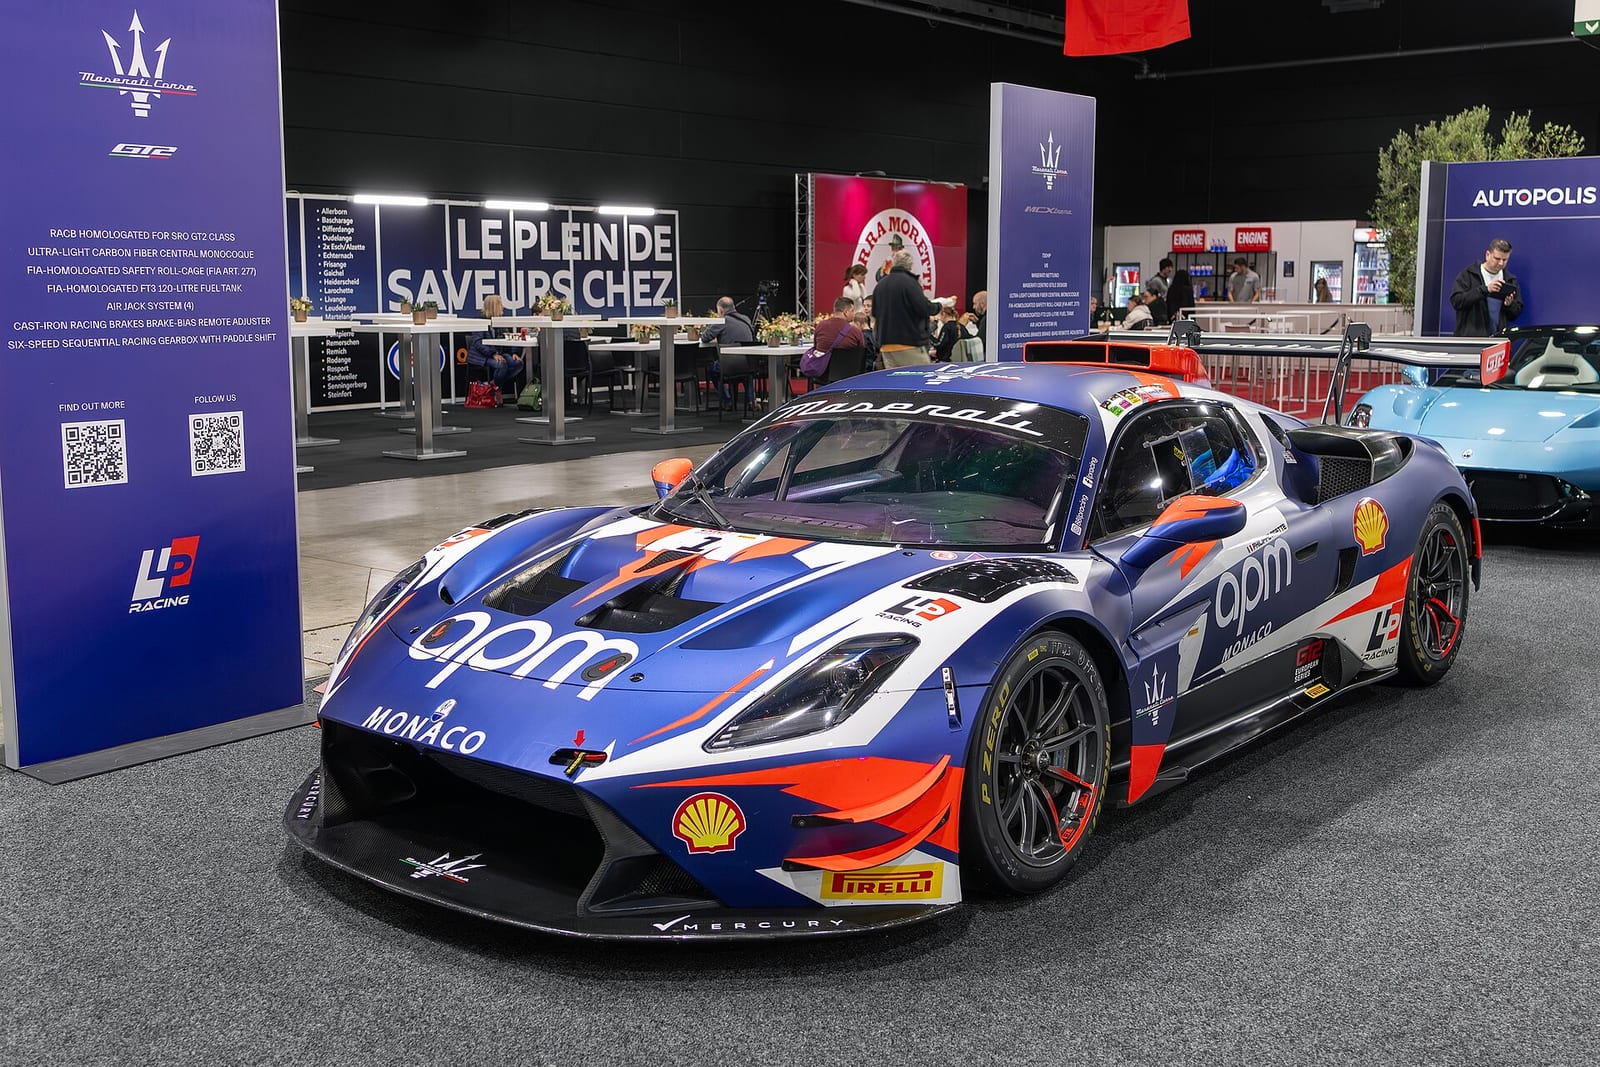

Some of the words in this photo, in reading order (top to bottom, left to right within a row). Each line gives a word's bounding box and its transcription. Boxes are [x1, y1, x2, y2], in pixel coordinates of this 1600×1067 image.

[79, 71, 153, 87] Maserati
[153, 79, 197, 92] Corse
[111, 143, 178, 156] GT2
[1472, 186, 1598, 208] AUTOPOLIS
[50, 228, 77, 238] RACB
[79, 229, 150, 240] HOMOLOGATED
[152, 231, 170, 240] FOR
[171, 232, 189, 240] SRO
[191, 232, 207, 241] GT2
[208, 233, 236, 241] CLASS
[322, 226, 355, 235] Differdange
[1237, 231, 1269, 244] ENGINE
[457, 218, 504, 260] LE
[515, 219, 619, 262] PLEIN
[629, 224, 673, 263] DE
[1173, 233, 1204, 246] ENGINE
[28, 247, 90, 257] ULTRA-LIGHT
[92, 248, 131, 257] CARBON
[133, 248, 158, 258] FIBER
[160, 249, 199, 258] CENTRAL
[200, 249, 255, 259] MONOCOQUE
[888, 216, 932, 292] MORETTI
[27, 265, 120, 275] FIA-HOMOLOGATED
[122, 266, 156, 275] SAFETY
[157, 266, 205, 275] ROLL-CAGE
[206, 266, 223, 277] (FIA
[223, 267, 240, 276] ART.
[241, 267, 257, 277] 277)
[47, 284, 139, 293] FIA-HOMOLOGATED
[140, 283, 157, 293] FT3
[158, 283, 199, 293] 120-LITRE
[200, 283, 220, 293] FUEL
[221, 283, 243, 293] TANK
[387, 269, 575, 313] SAVEURS
[582, 270, 673, 309] CHEZ
[106, 302, 122, 311] AIR
[123, 301, 146, 311] JACK
[147, 301, 182, 311] SYSTEM
[184, 301, 195, 312] (4)
[13, 320, 68, 331] CAST-IRON
[70, 320, 107, 330] RACING
[109, 319, 145, 329] BRAKES
[146, 318, 197, 328] BRAKE-BIAS
[198, 317, 231, 327] REMOTE
[232, 316, 271, 326] ADJUSTER
[7, 339, 60, 350] SIX-SPEED
[62, 337, 121, 348] SEQUENTIAL
[121, 336, 157, 347] RACING
[158, 335, 199, 345] GEARBOX
[200, 334, 221, 344] WITH
[222, 333, 253, 343] PADDLE
[254, 333, 277, 342] SHIFT
[59, 403, 80, 412] FIND
[81, 402, 99, 411] OUT
[100, 400, 126, 410] MORE
[194, 394, 225, 404] FOLLOW
[226, 393, 237, 402] US
[771, 399, 1044, 437] Maserati
[1215, 537, 1292, 637] apm
[128, 595, 190, 614] RACING
[874, 612, 923, 628] RACING
[1221, 621, 1272, 664] MONACO
[408, 611, 640, 702] apm
[1295, 659, 1320, 676] EUROPEAN
[1294, 670, 1311, 683] SERIES
[361, 705, 488, 755] MONACO
[982, 681, 1010, 776] ZERO
[981, 783, 991, 805] P
[831, 869, 935, 894] PIRELLI
[682, 918, 845, 932] MERCURY
